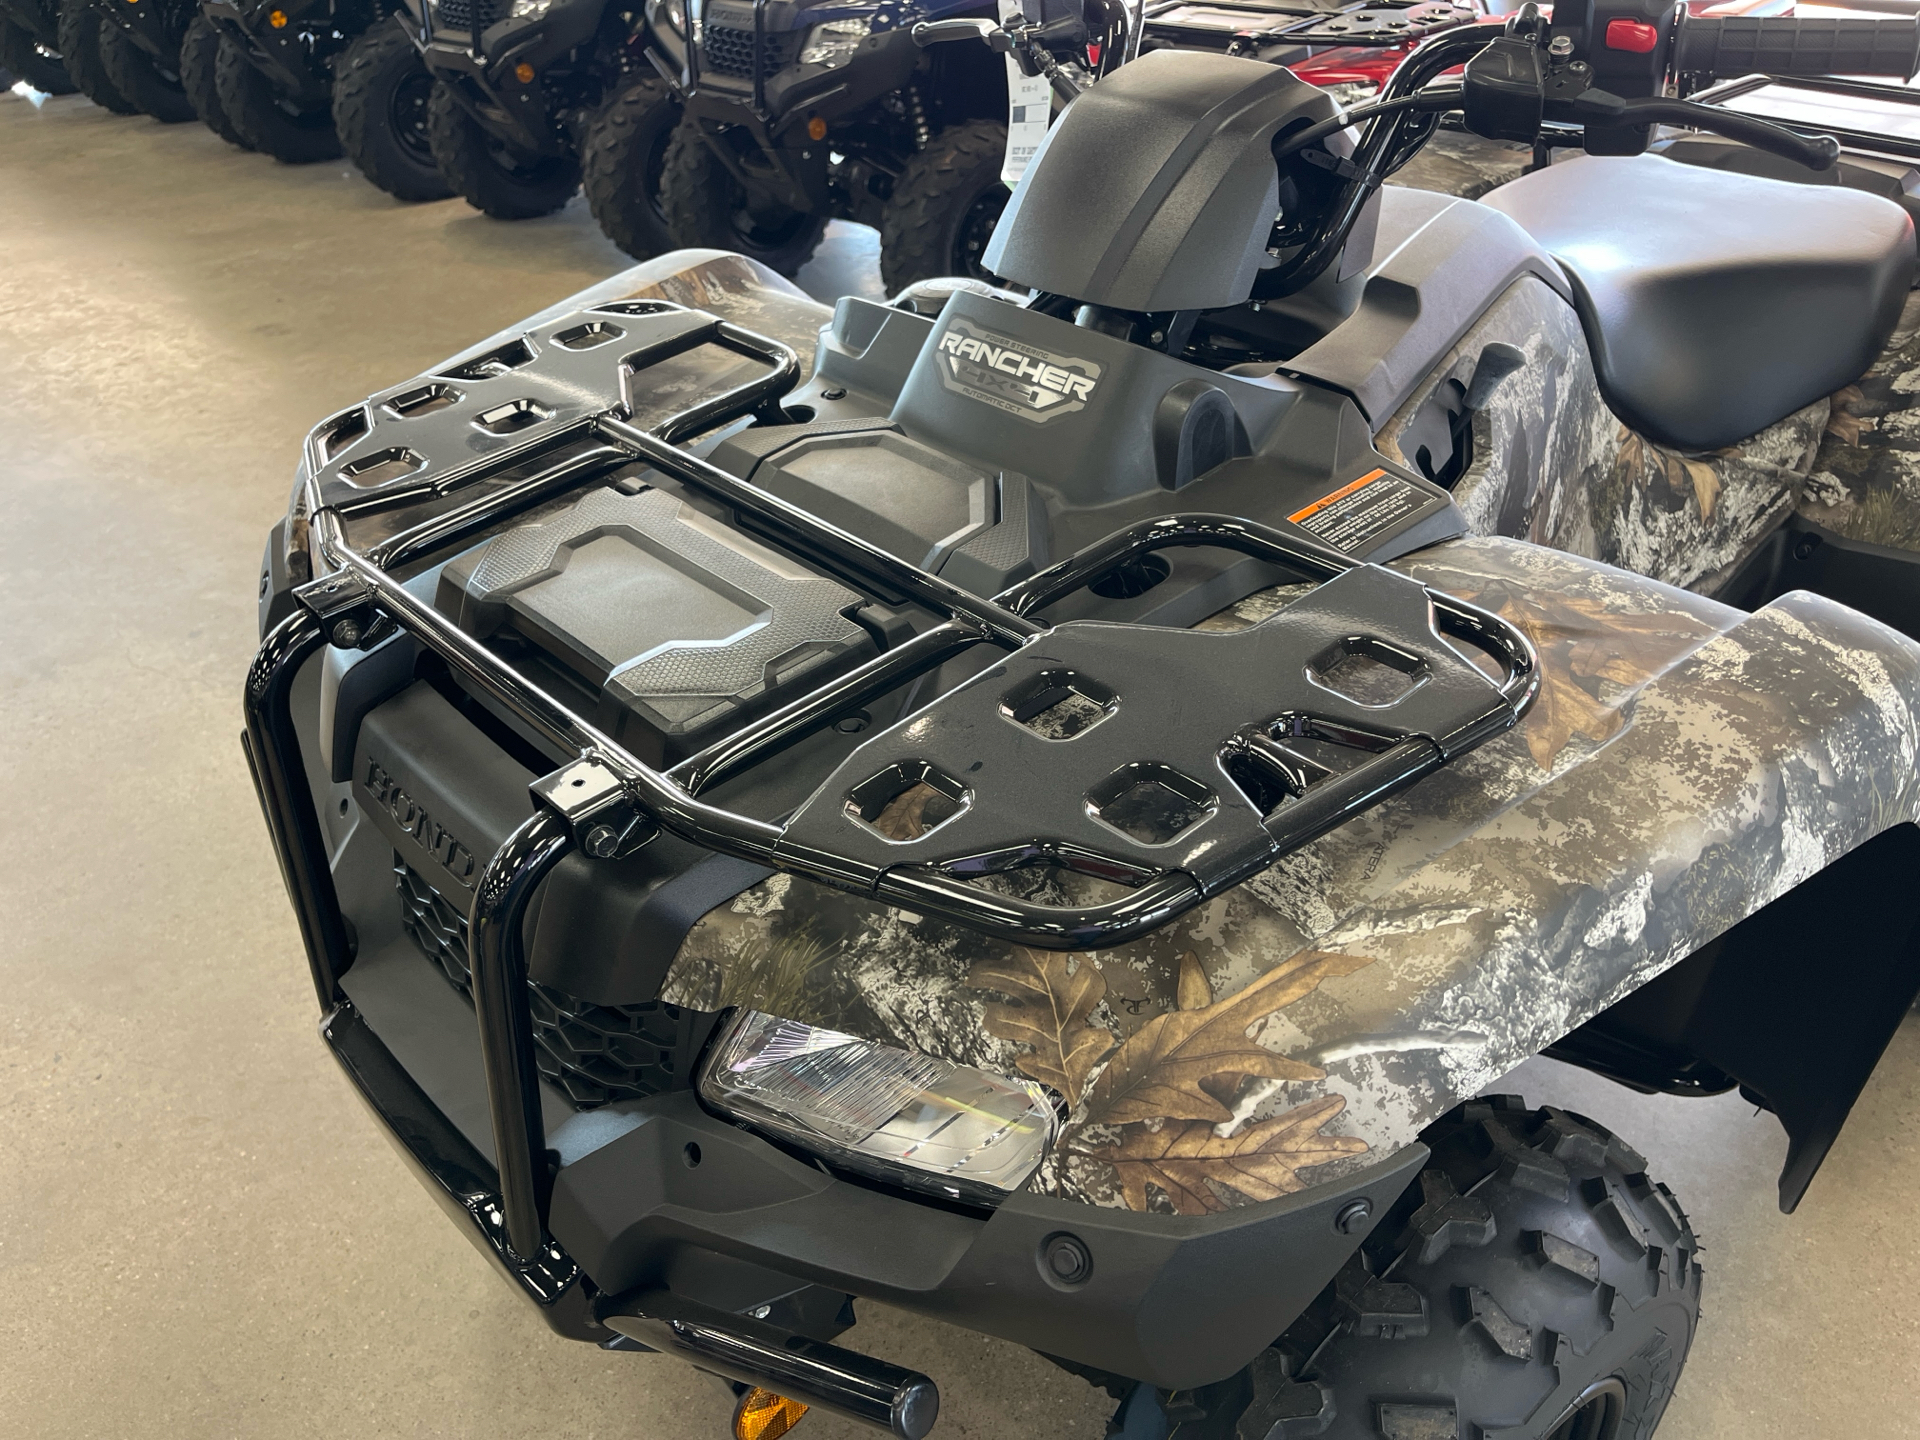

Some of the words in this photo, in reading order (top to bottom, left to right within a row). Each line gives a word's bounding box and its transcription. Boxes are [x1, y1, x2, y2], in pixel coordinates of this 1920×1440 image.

[938, 331, 1096, 402] RANCHER
[984, 333, 1010, 347] POWER
[1010, 342, 1050, 360] STEERING
[962, 387, 1005, 407] AUTOMATIC
[1004, 403, 1022, 414] DCT
[363, 755, 487, 895] HOND
